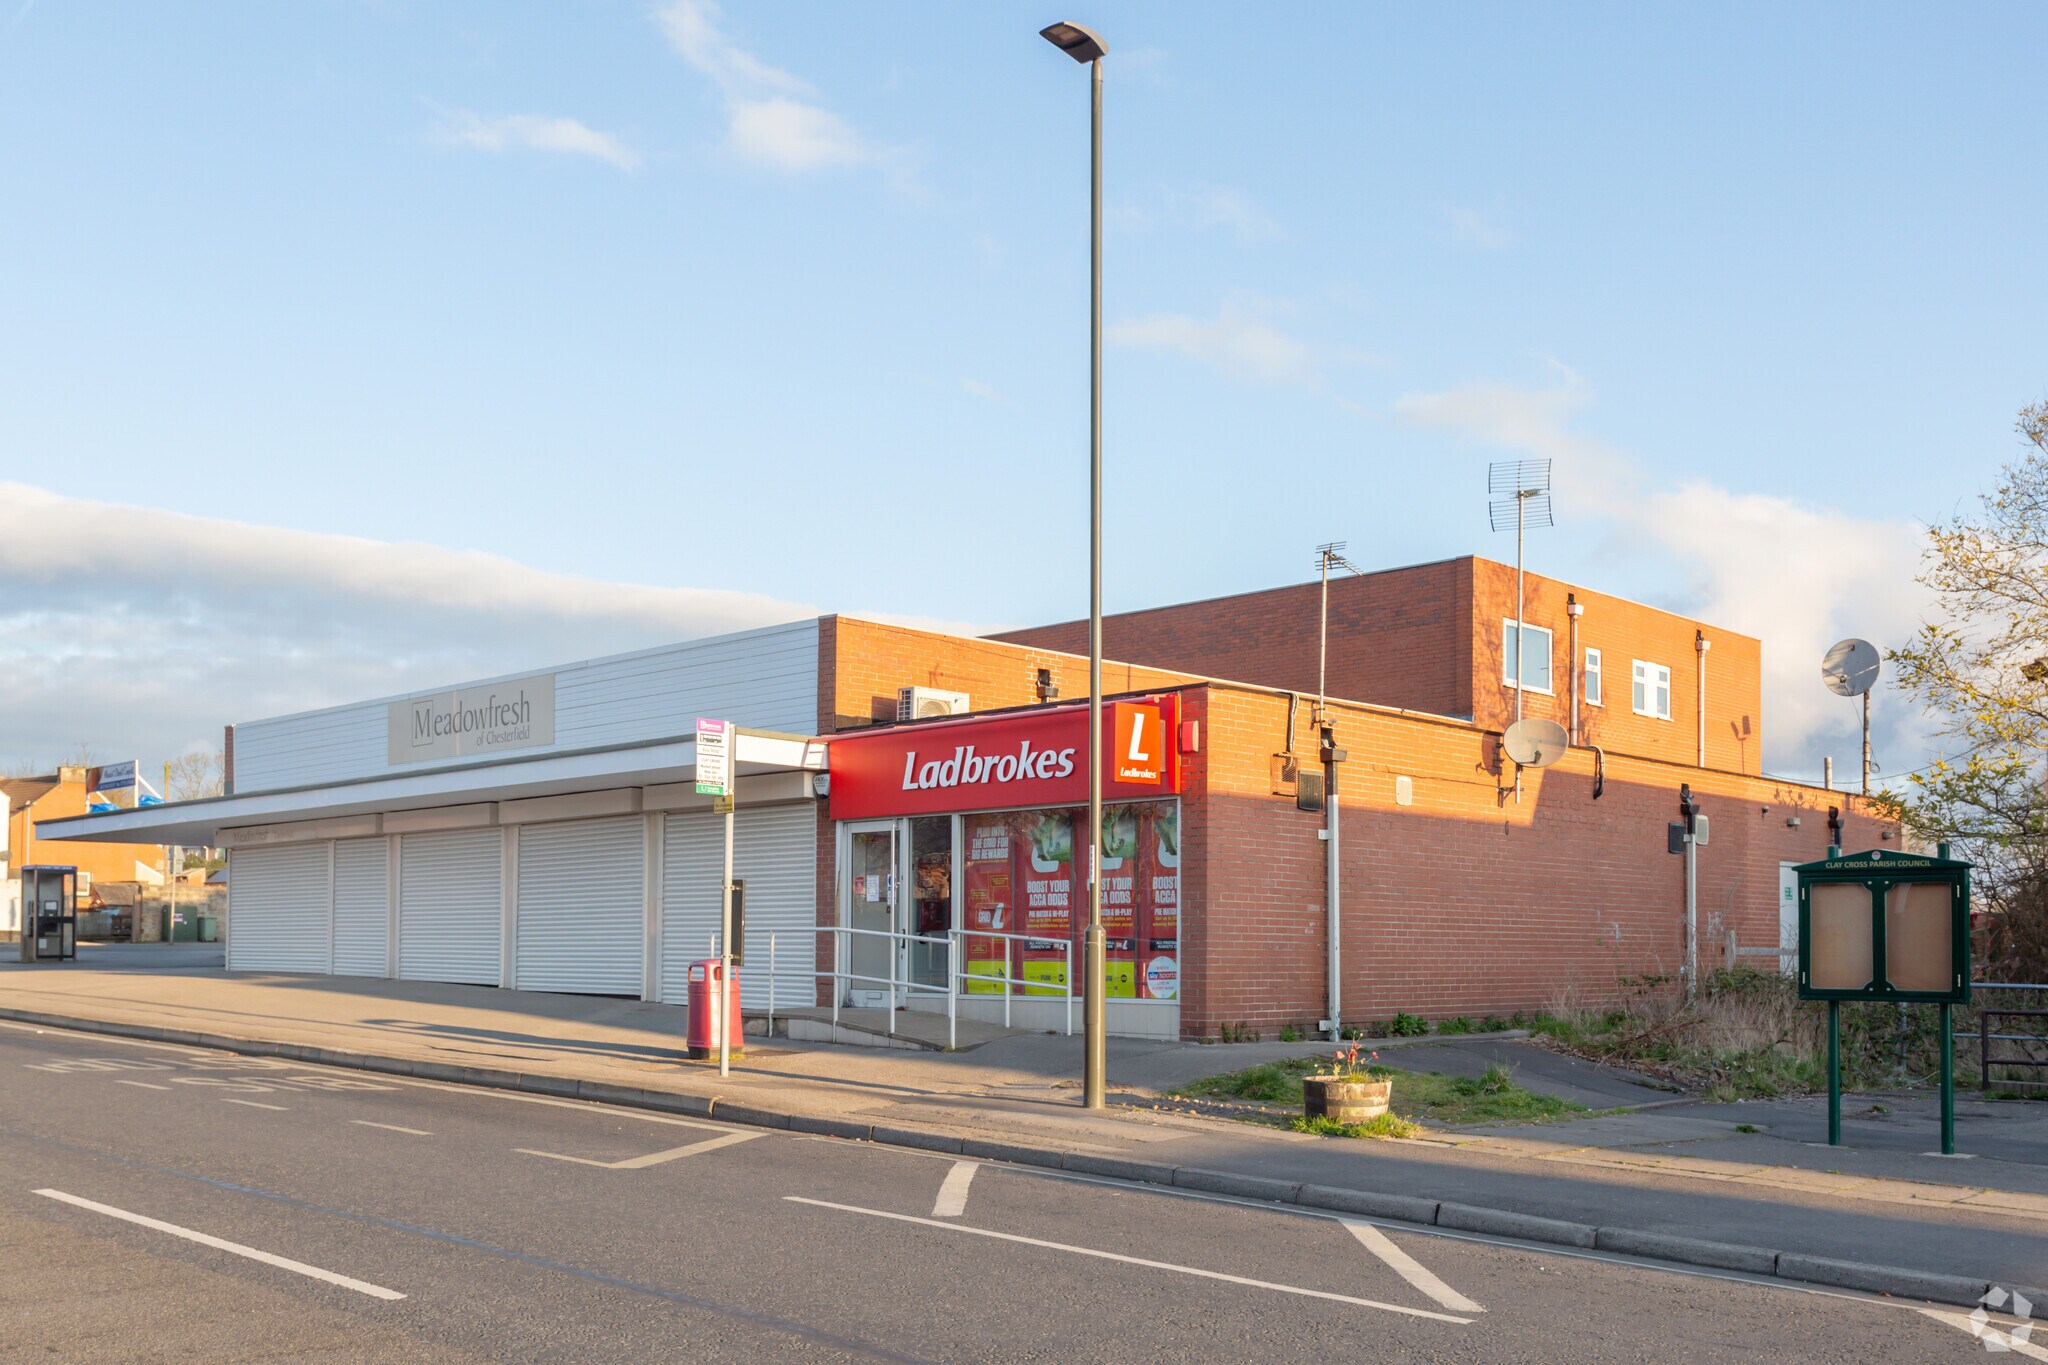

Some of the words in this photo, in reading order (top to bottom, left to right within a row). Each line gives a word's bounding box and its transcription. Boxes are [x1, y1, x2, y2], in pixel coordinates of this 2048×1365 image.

[414, 690, 530, 740] Meadowfresh
[476, 731, 486, 746] of
[486, 725, 530, 745] Chesterfield
[1128, 712, 1149, 762] L
[902, 740, 1076, 790] Ladbrokes
[1120, 766, 1157, 779] Ladbrokes
[972, 838, 983, 849] THE
[997, 837, 1008, 848] FOR
[981, 848, 1008, 859] REWARDS
[1027, 880, 1048, 893] BOOST
[1050, 880, 1070, 892] YOUR
[1112, 877, 1132, 890] YOUR
[1152, 876, 1177, 889] BOOST
[1029, 894, 1046, 906] ACCA
[1048, 893, 1068, 906] ODDS
[1110, 891, 1131, 904] ODDS
[1155, 890, 1176, 903] ACCA
